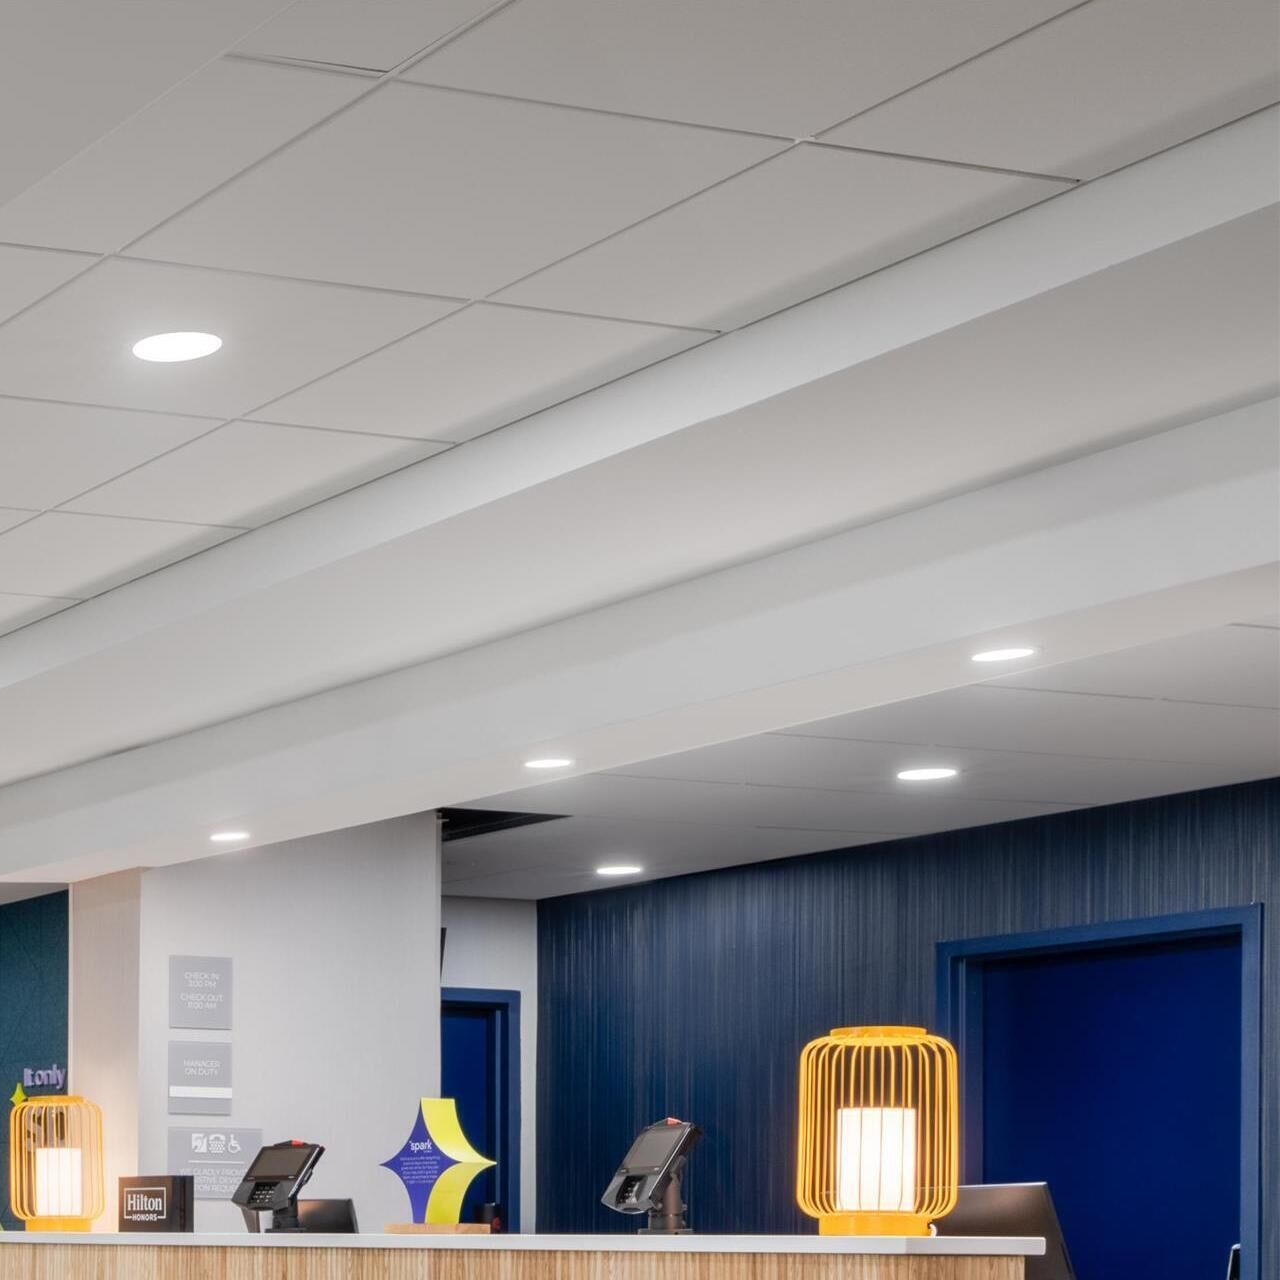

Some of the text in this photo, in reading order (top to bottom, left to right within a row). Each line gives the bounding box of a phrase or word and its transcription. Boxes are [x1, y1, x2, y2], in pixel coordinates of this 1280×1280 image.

[34, 1064, 66, 1089] only
[410, 1139, 432, 1153] spark
[127, 1194, 162, 1211] Hilton
[132, 1213, 157, 1221] HONORS
